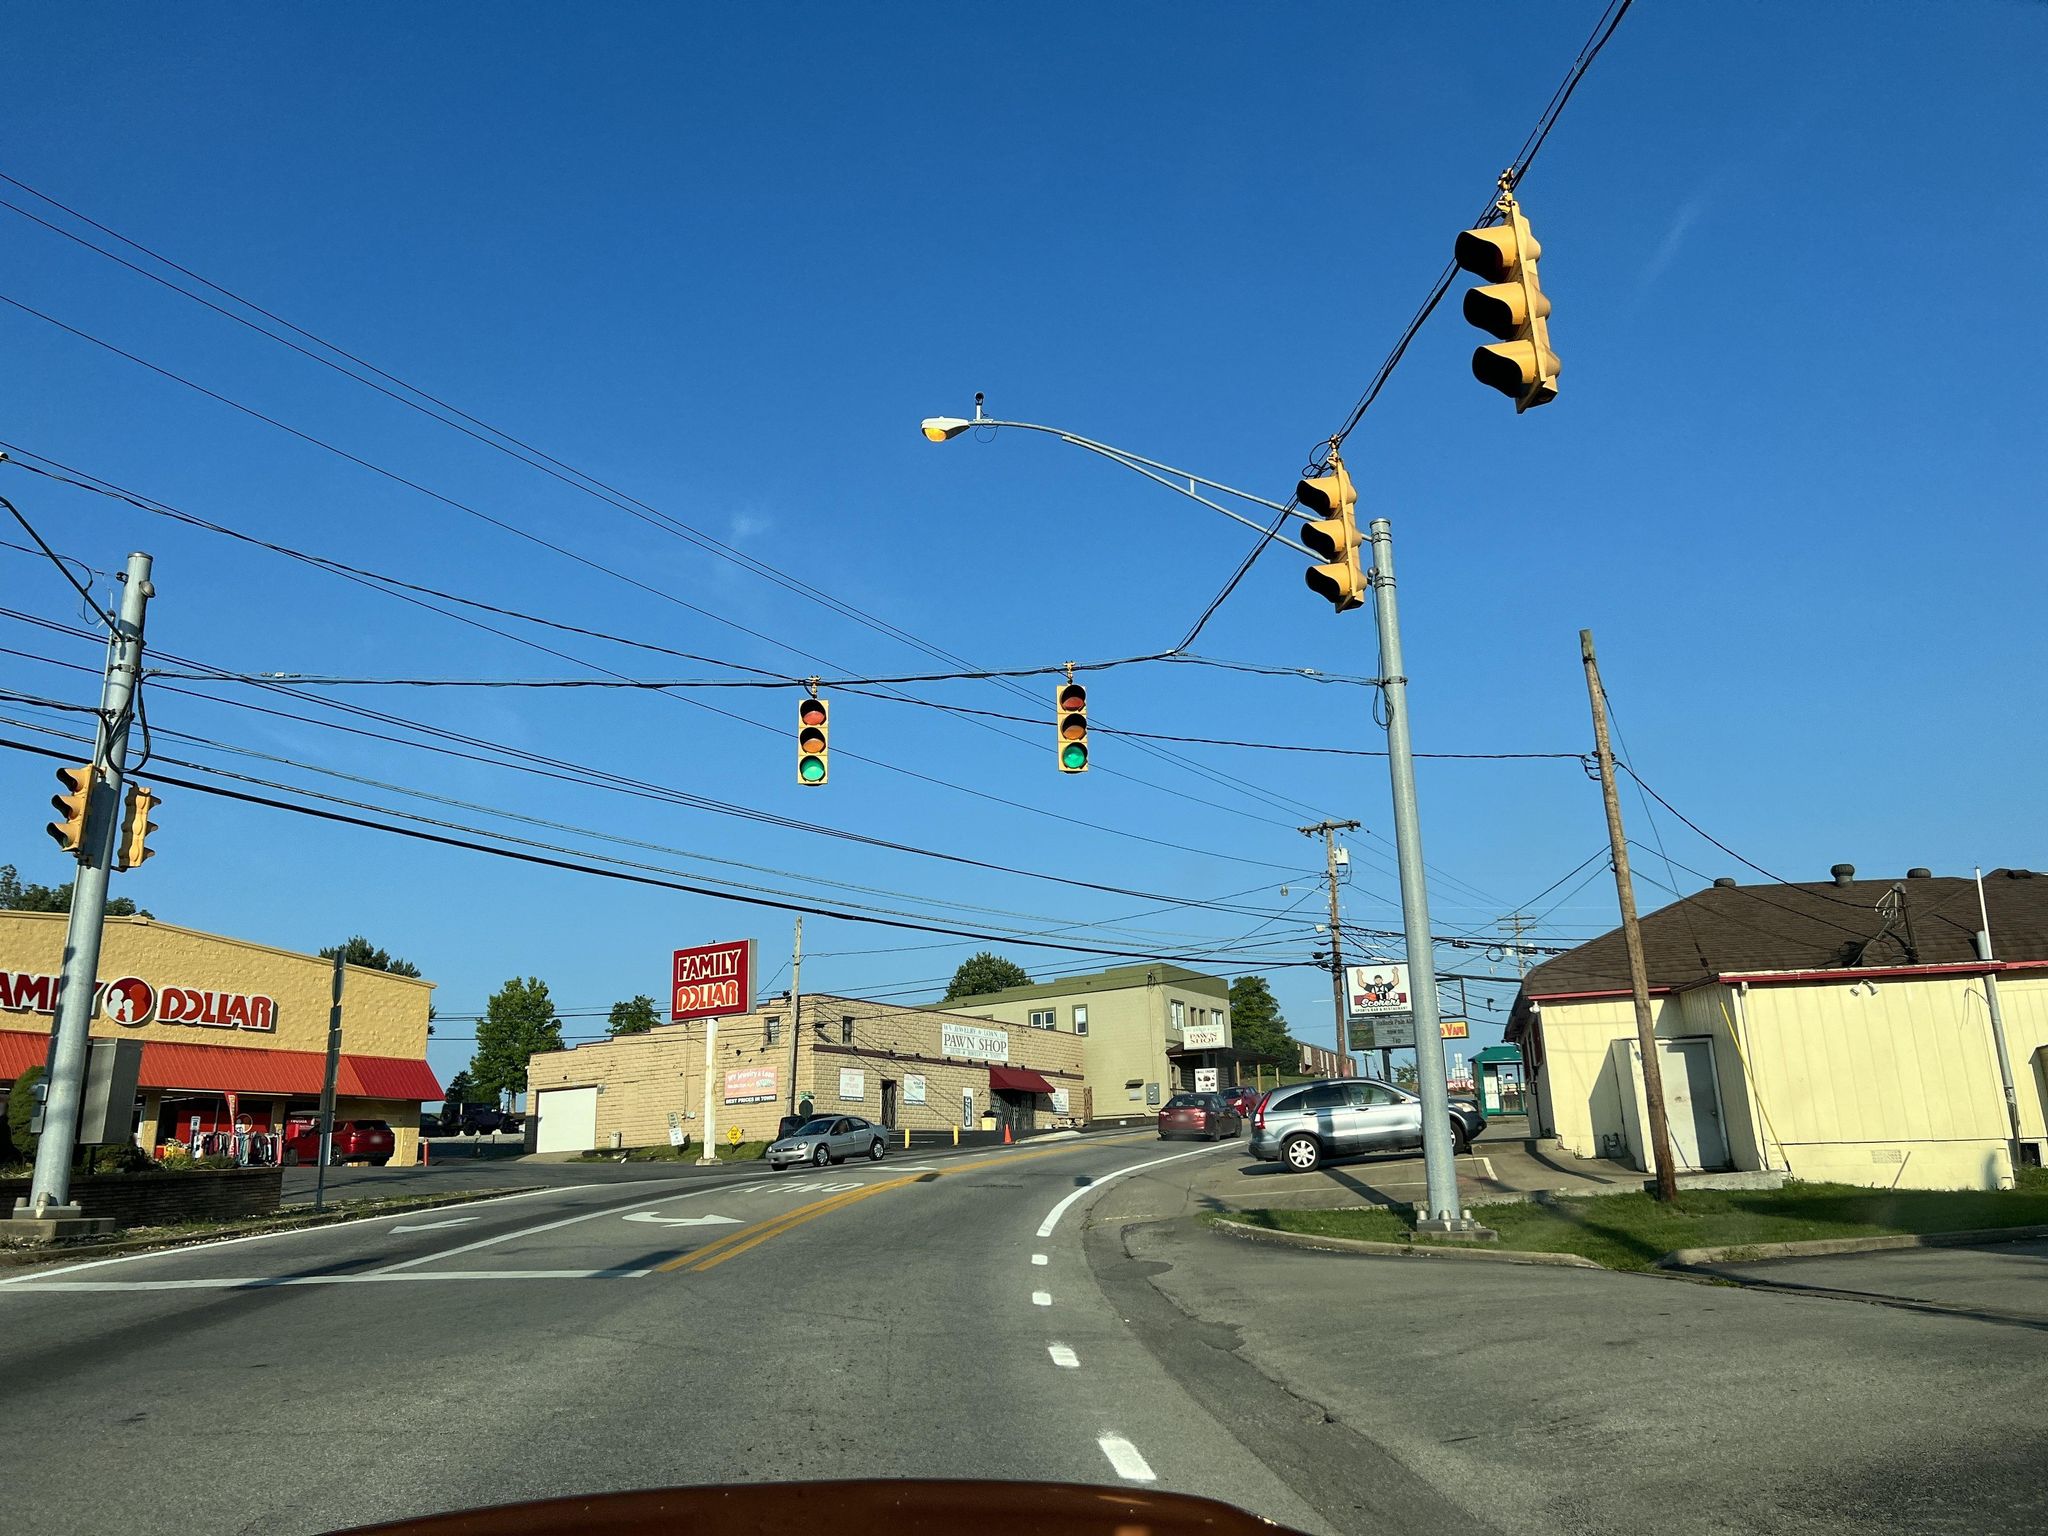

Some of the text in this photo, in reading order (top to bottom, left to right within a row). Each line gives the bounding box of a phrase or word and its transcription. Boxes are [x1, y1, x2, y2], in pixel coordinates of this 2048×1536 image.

[678, 949, 741, 982] FAMILY
[157, 986, 272, 1029] DOLLAR
[677, 980, 739, 1012] DOLLAR
[944, 1034, 1007, 1053] PAWN SHOP
